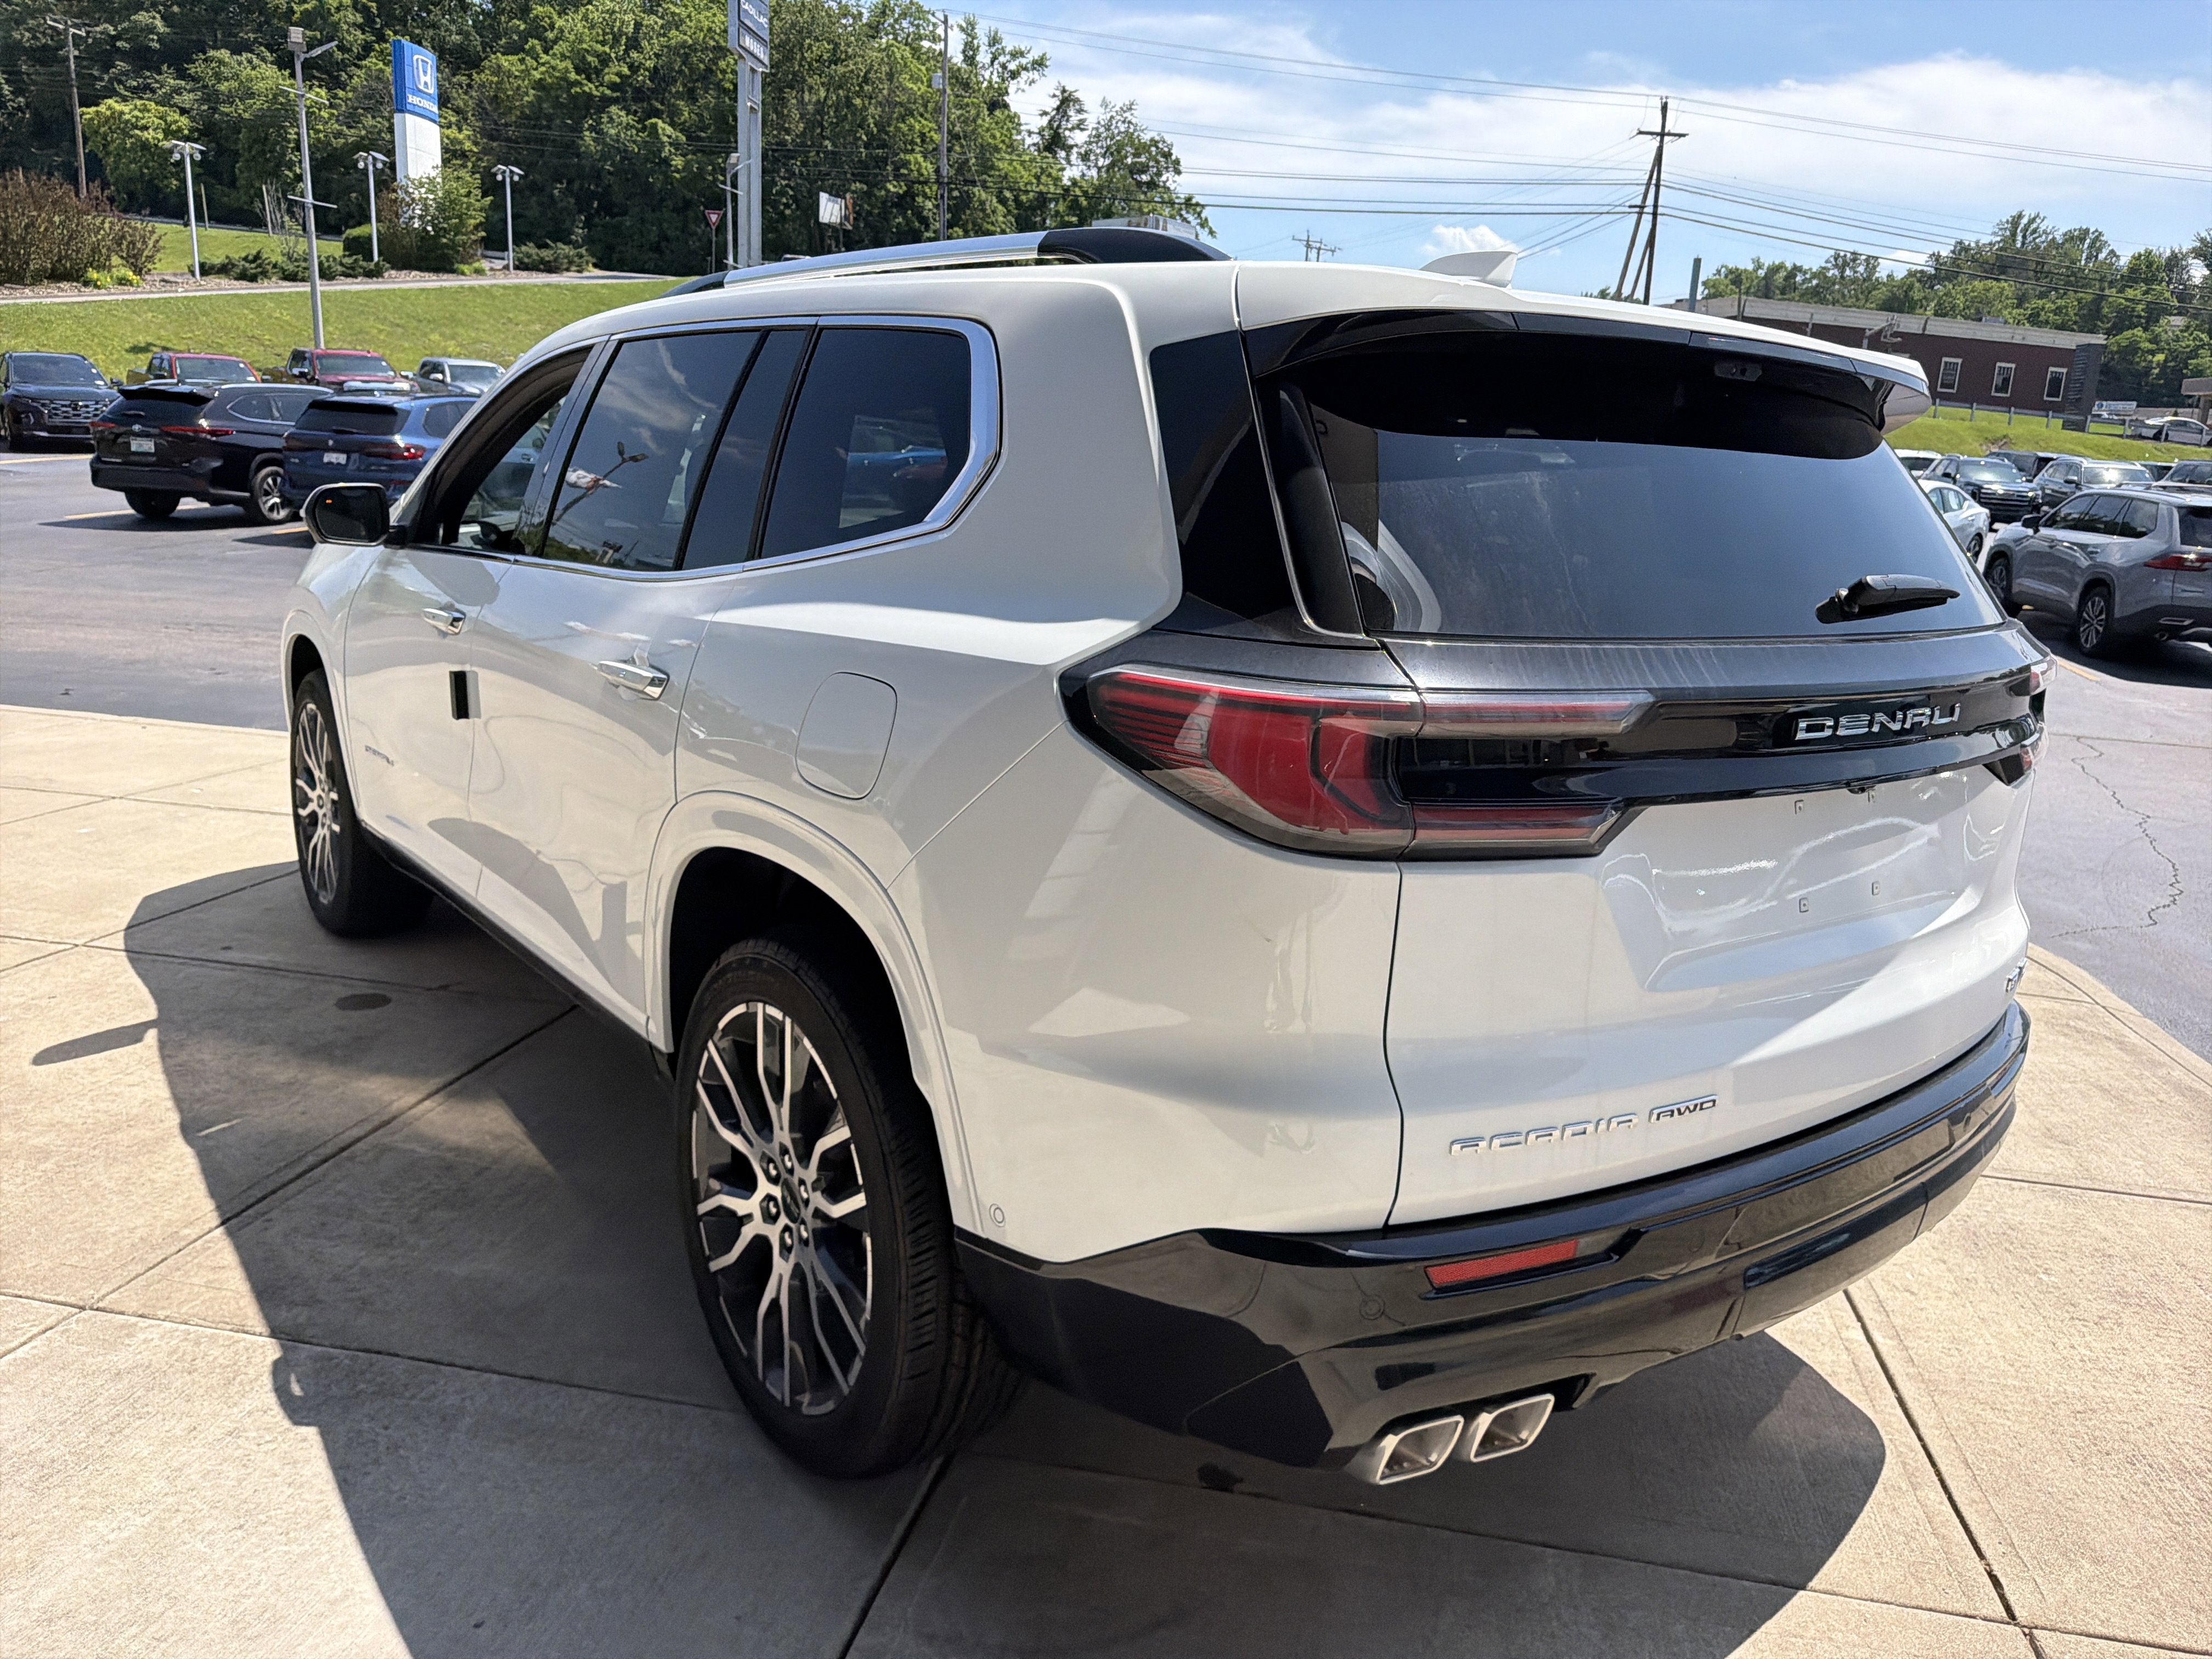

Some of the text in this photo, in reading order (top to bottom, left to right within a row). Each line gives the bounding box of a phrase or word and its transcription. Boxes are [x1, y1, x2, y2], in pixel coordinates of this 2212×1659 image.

[1794, 703, 1961, 741] DENALI
[1449, 1094, 1719, 1156] ACADIA AWD
